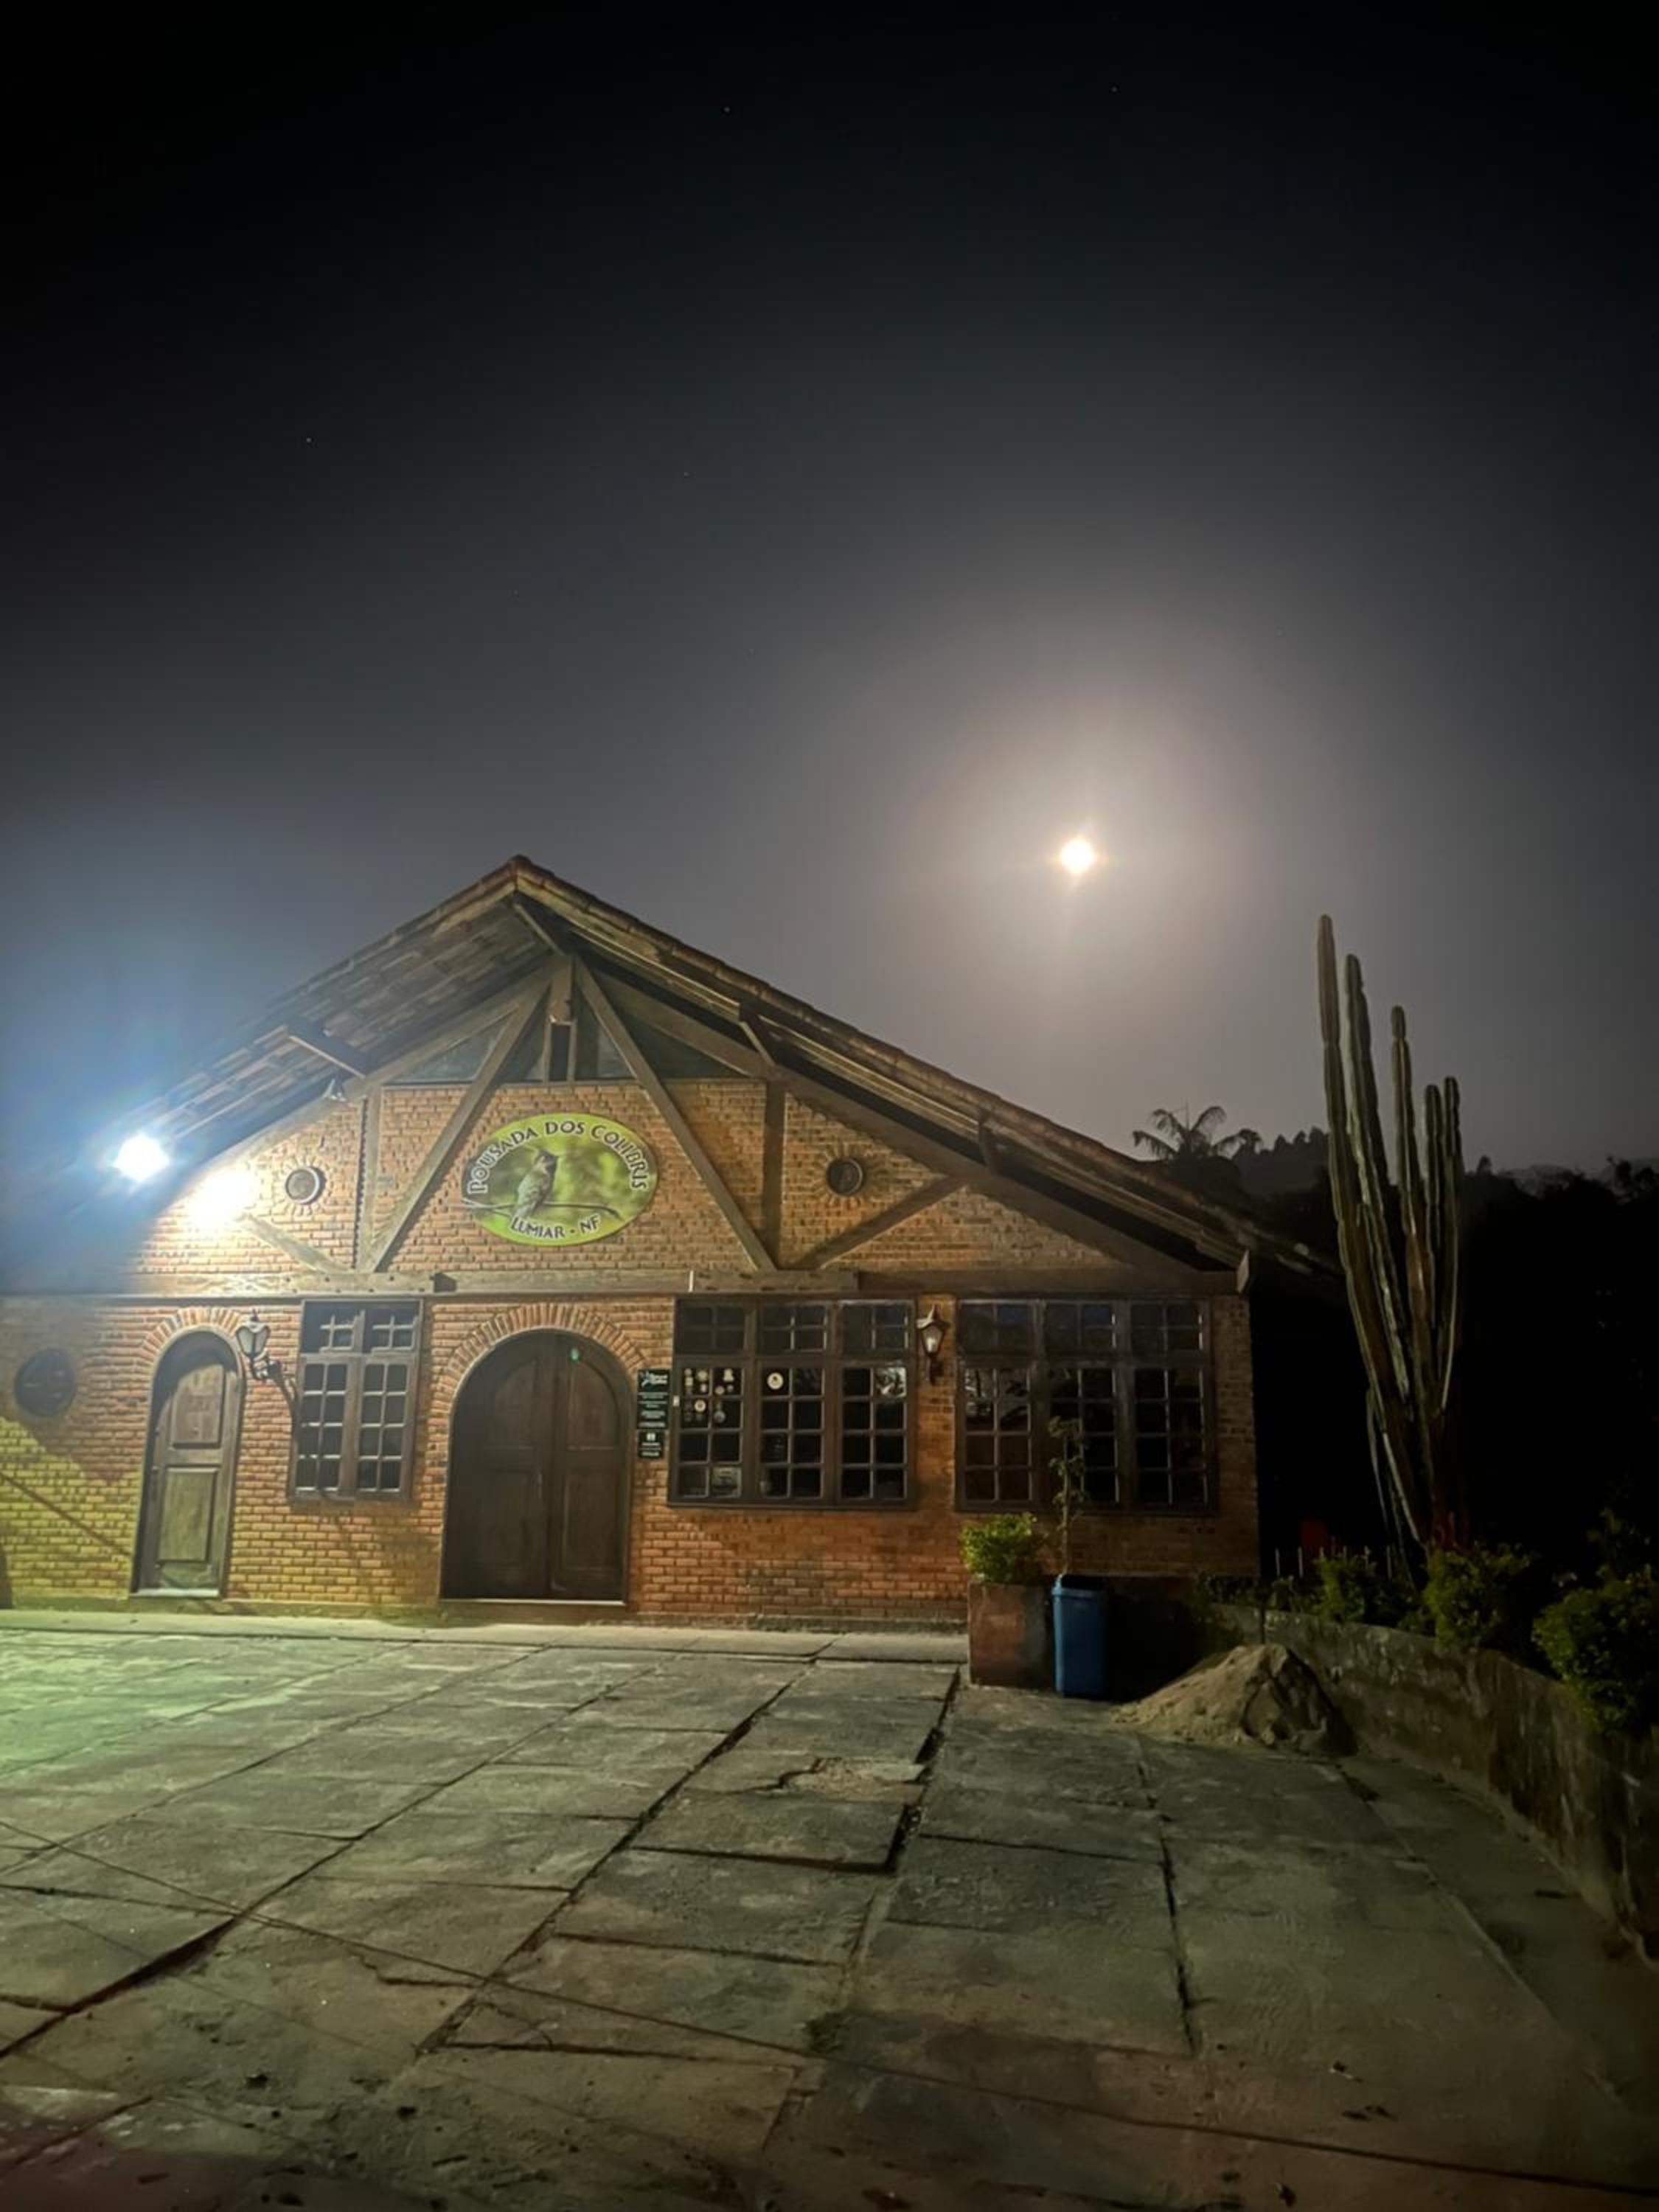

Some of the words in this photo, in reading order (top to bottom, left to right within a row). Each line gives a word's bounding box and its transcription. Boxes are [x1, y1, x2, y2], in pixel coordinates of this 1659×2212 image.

[468, 1127, 538, 1194] POUSADA
[545, 1121, 585, 1135] DOS
[591, 1125, 647, 1190] COLIBRIS
[510, 1217, 565, 1239] LUMIAR
[580, 1216, 599, 1234] NF
